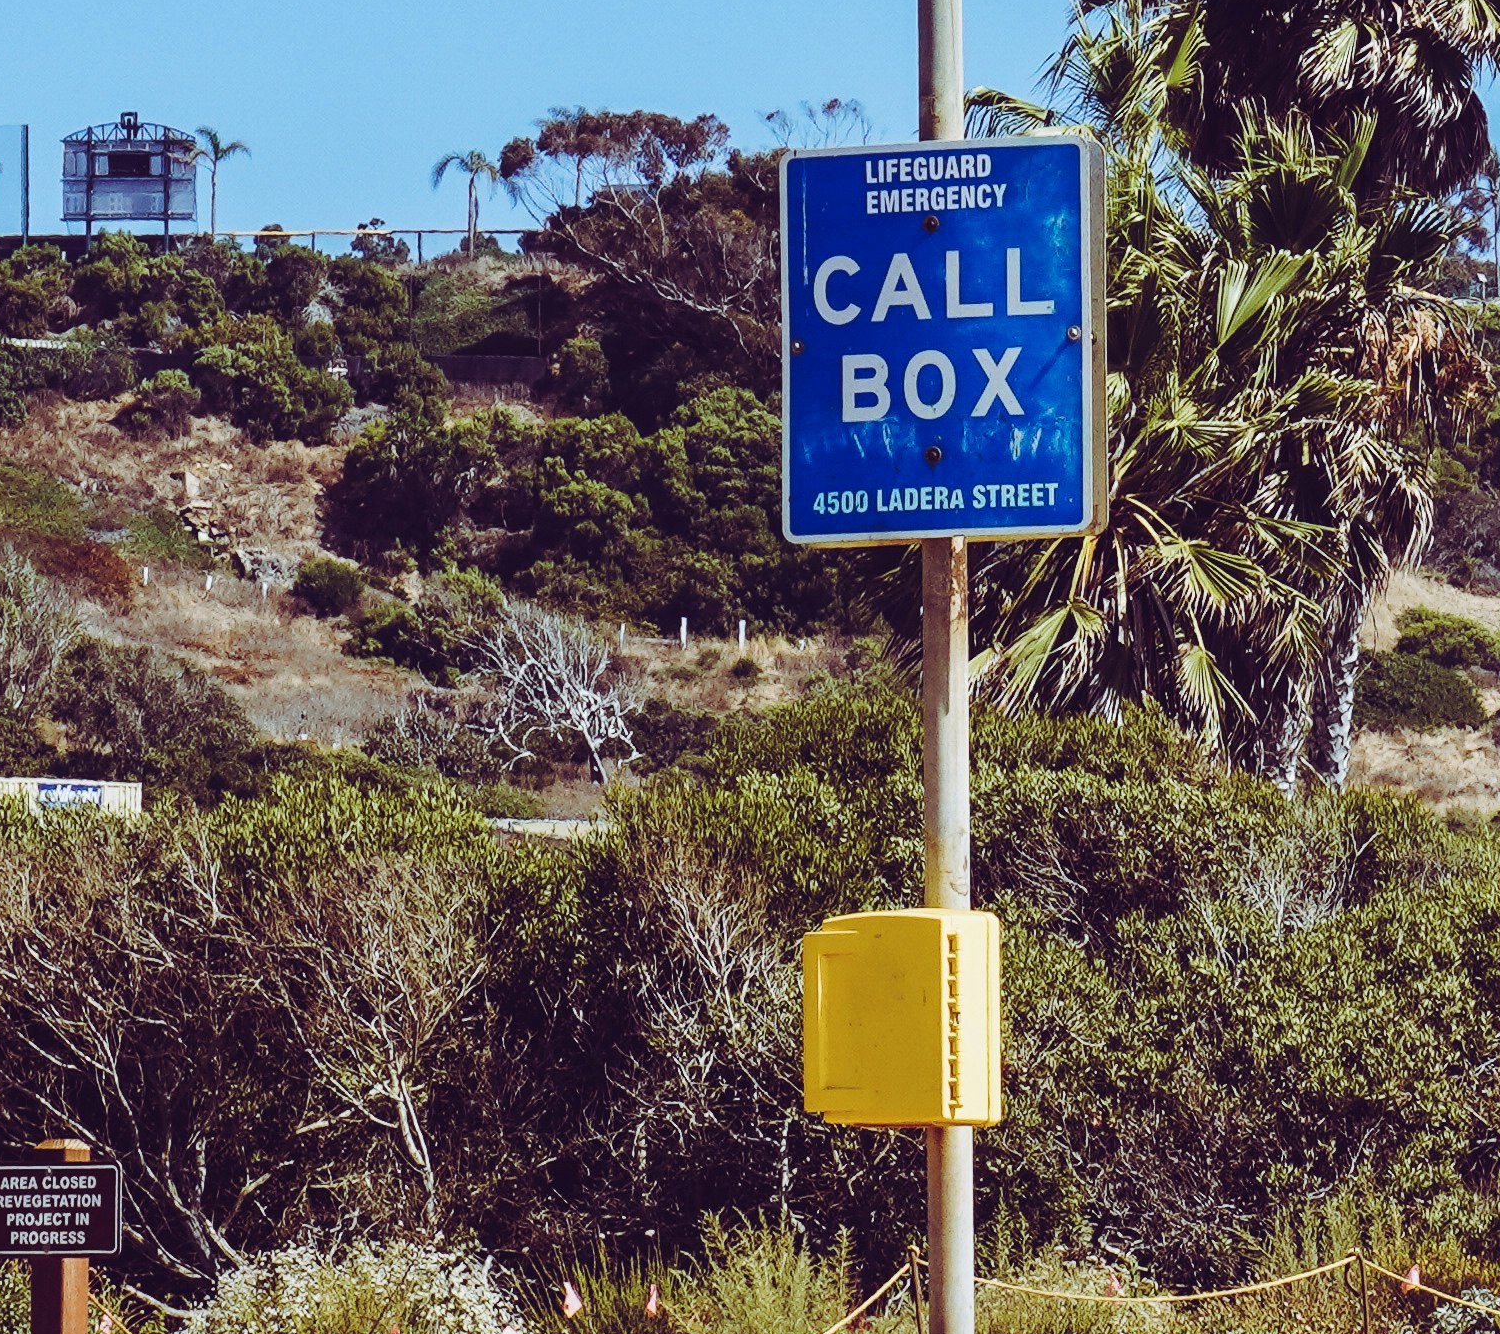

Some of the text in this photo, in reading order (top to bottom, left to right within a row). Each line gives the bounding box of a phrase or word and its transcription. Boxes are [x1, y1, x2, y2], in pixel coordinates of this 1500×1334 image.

[865, 154, 992, 184] LIFEGUARD
[866, 184, 1007, 214] EMERGENCY
[813, 247, 1055, 325] CALL
[842, 347, 1025, 423] BOX
[813, 482, 1059, 514] 4500 LADERA STREET
[0, 1175, 97, 1190] AREA CLOSED
[6, 1212, 90, 1226] PROJECT IN
[10, 1230, 86, 1245] PROGRESS
